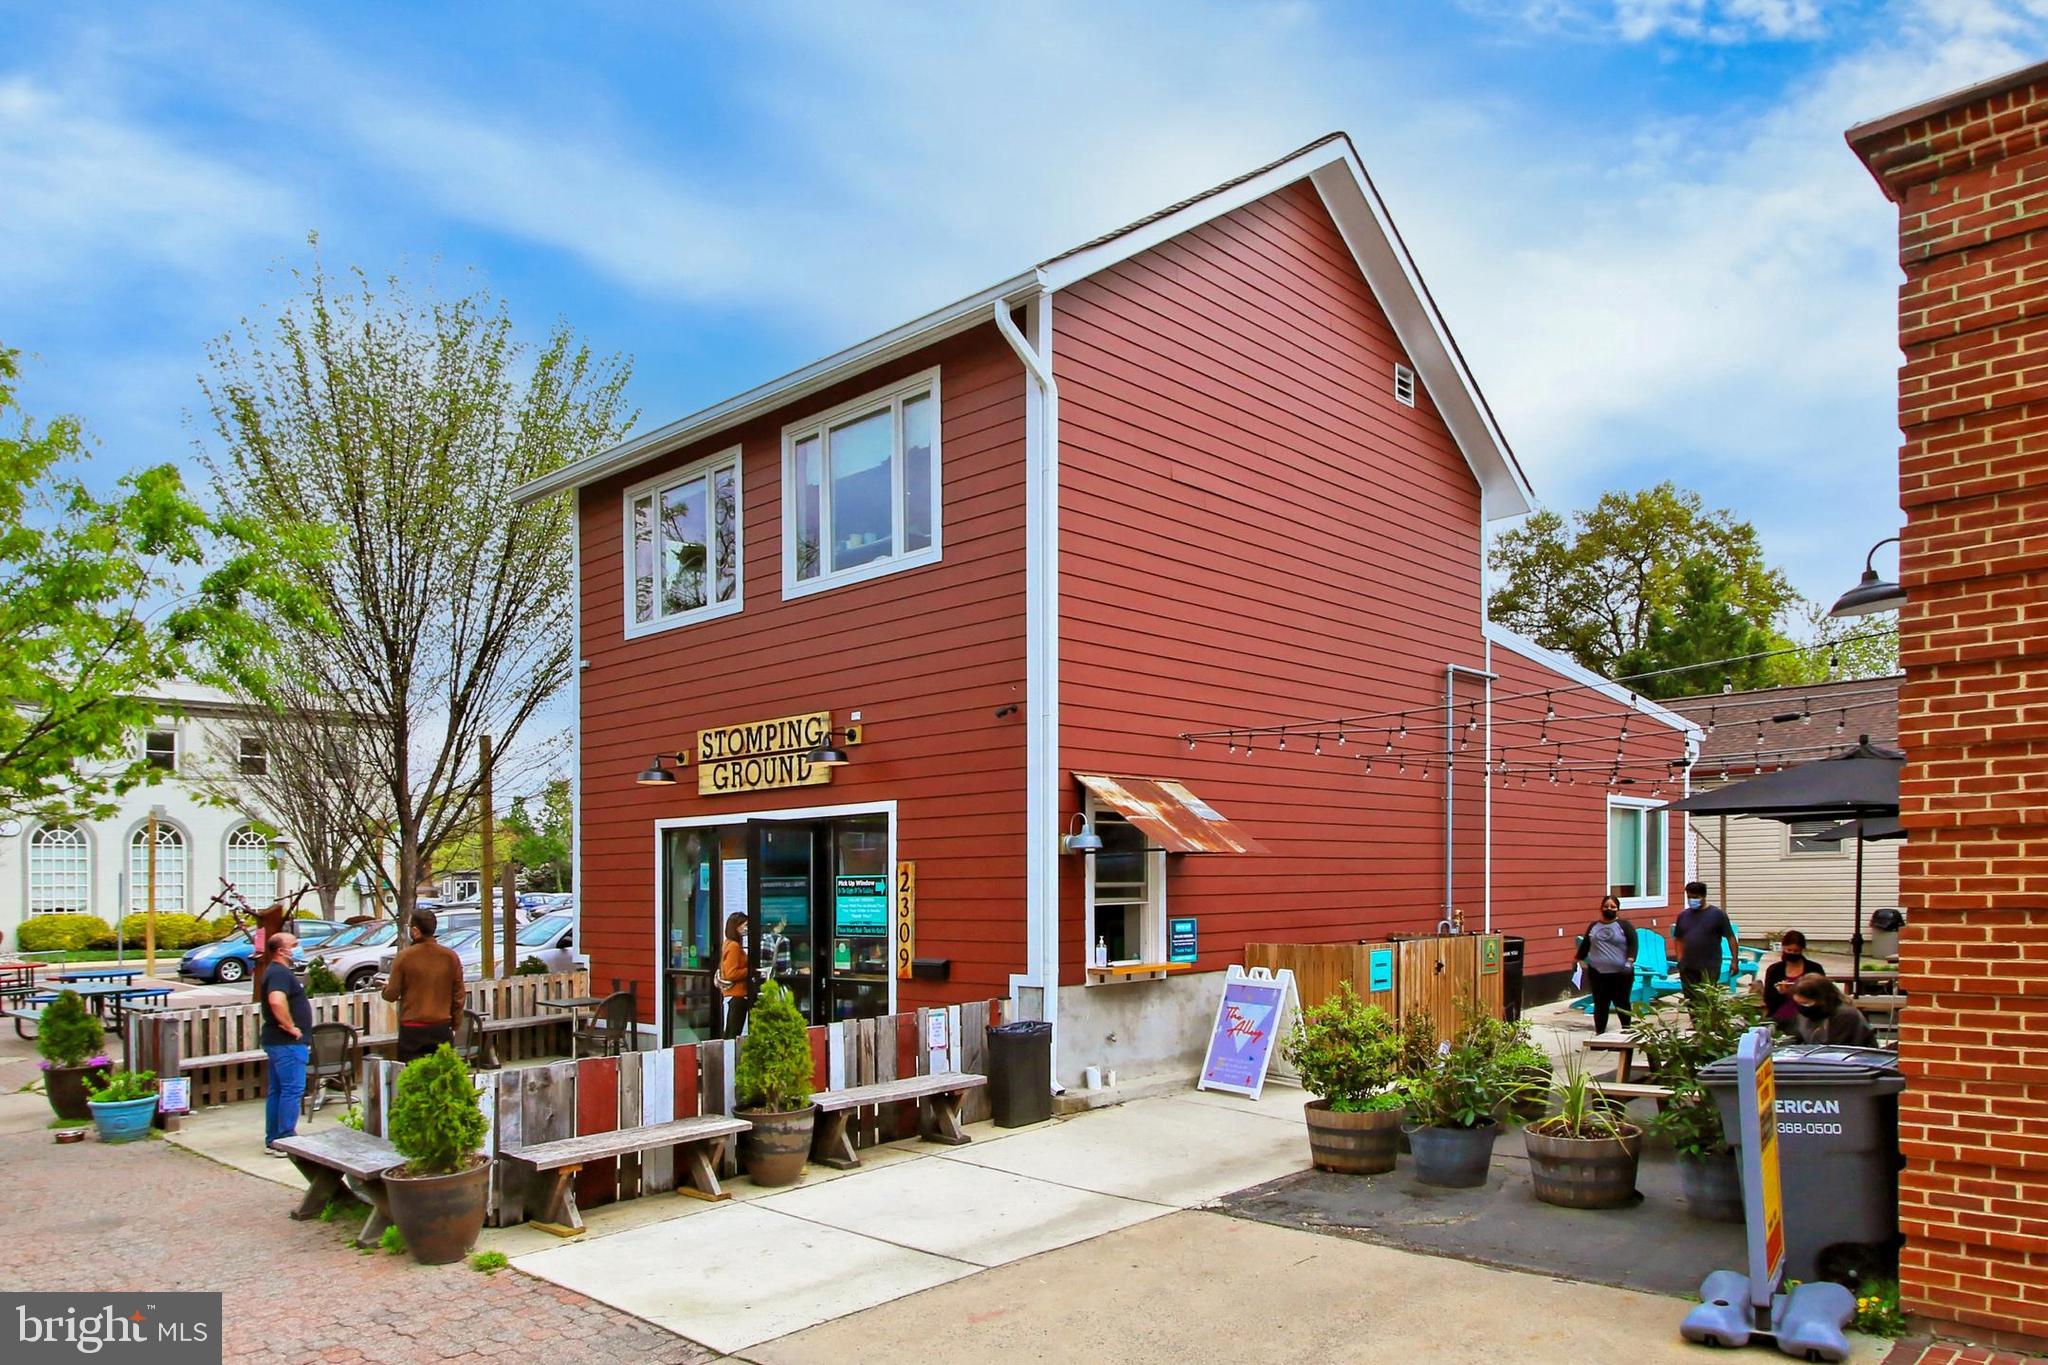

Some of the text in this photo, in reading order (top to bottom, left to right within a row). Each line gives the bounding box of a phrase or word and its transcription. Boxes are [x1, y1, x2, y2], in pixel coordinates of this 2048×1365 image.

[702, 716, 824, 760] STOMPING
[713, 754, 812, 790] GROUND
[900, 871, 910, 969] 2309
[1226, 1006, 1244, 1021] The
[1227, 1019, 1264, 1044] Alley
[1775, 1100, 1840, 1114] ERICAN
